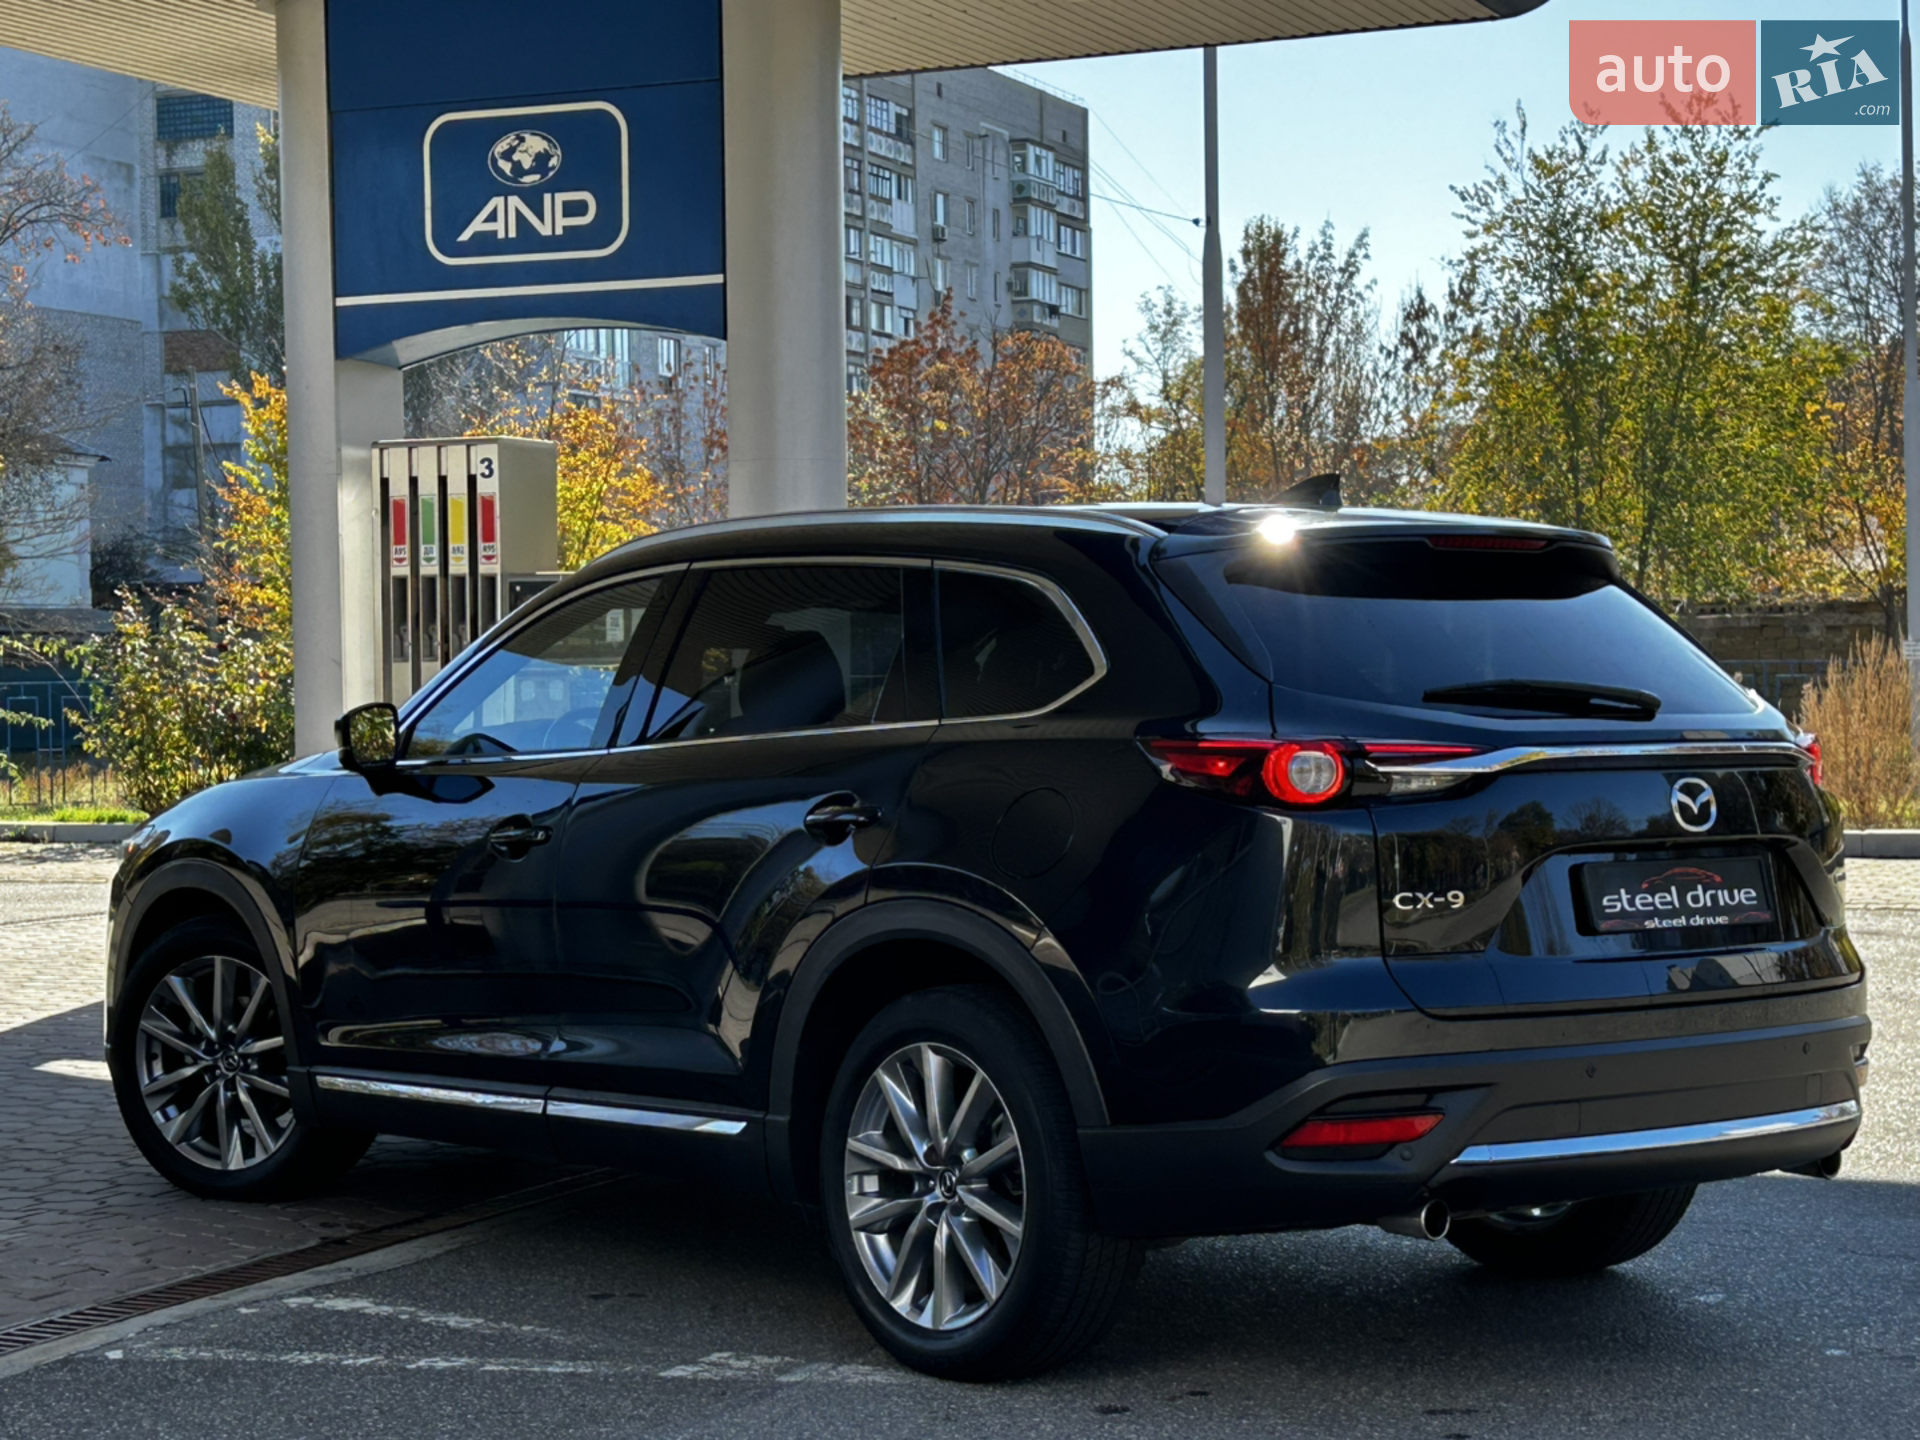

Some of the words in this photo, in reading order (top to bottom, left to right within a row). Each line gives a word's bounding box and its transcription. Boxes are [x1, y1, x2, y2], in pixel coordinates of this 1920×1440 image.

[456, 190, 597, 242] ANP
[479, 457, 495, 479] 3
[1392, 890, 1465, 910] CX-9
[1602, 885, 1680, 913] steel
[1686, 884, 1758, 908] drive
[1643, 915, 1687, 929] steel
[1689, 914, 1729, 927] drive
